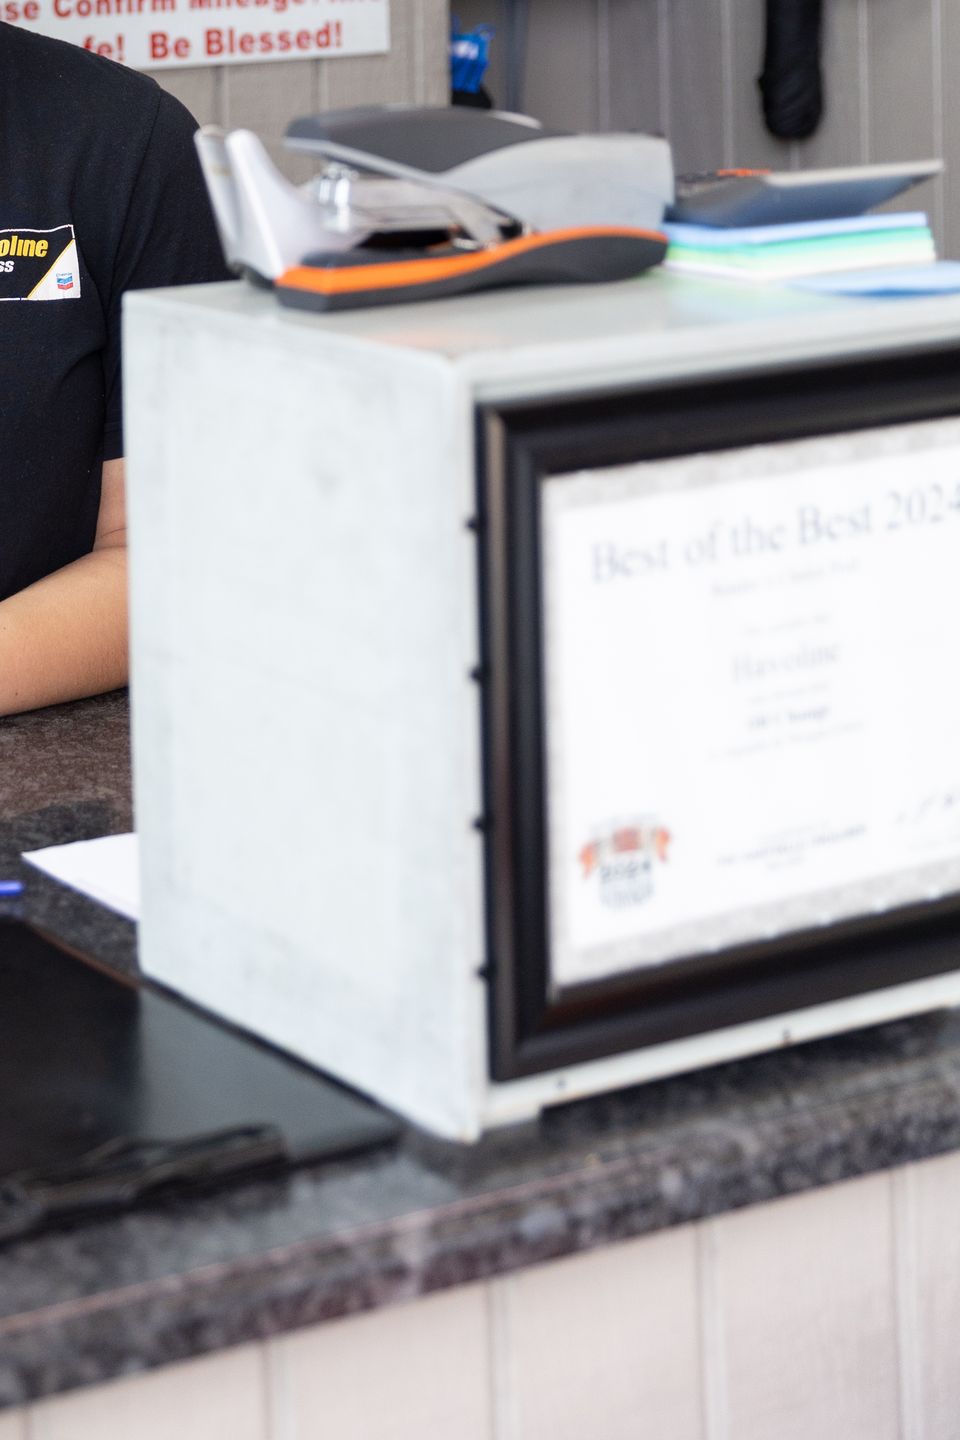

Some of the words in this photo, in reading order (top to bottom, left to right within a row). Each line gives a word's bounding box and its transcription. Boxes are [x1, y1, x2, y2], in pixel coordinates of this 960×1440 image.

[150, 31, 190, 60] Be
[205, 20, 343, 57] Blessed!
[590, 541, 670, 585] Best
[684, 520, 724, 565] of
[729, 515, 787, 559] the
[797, 504, 873, 546] Best
